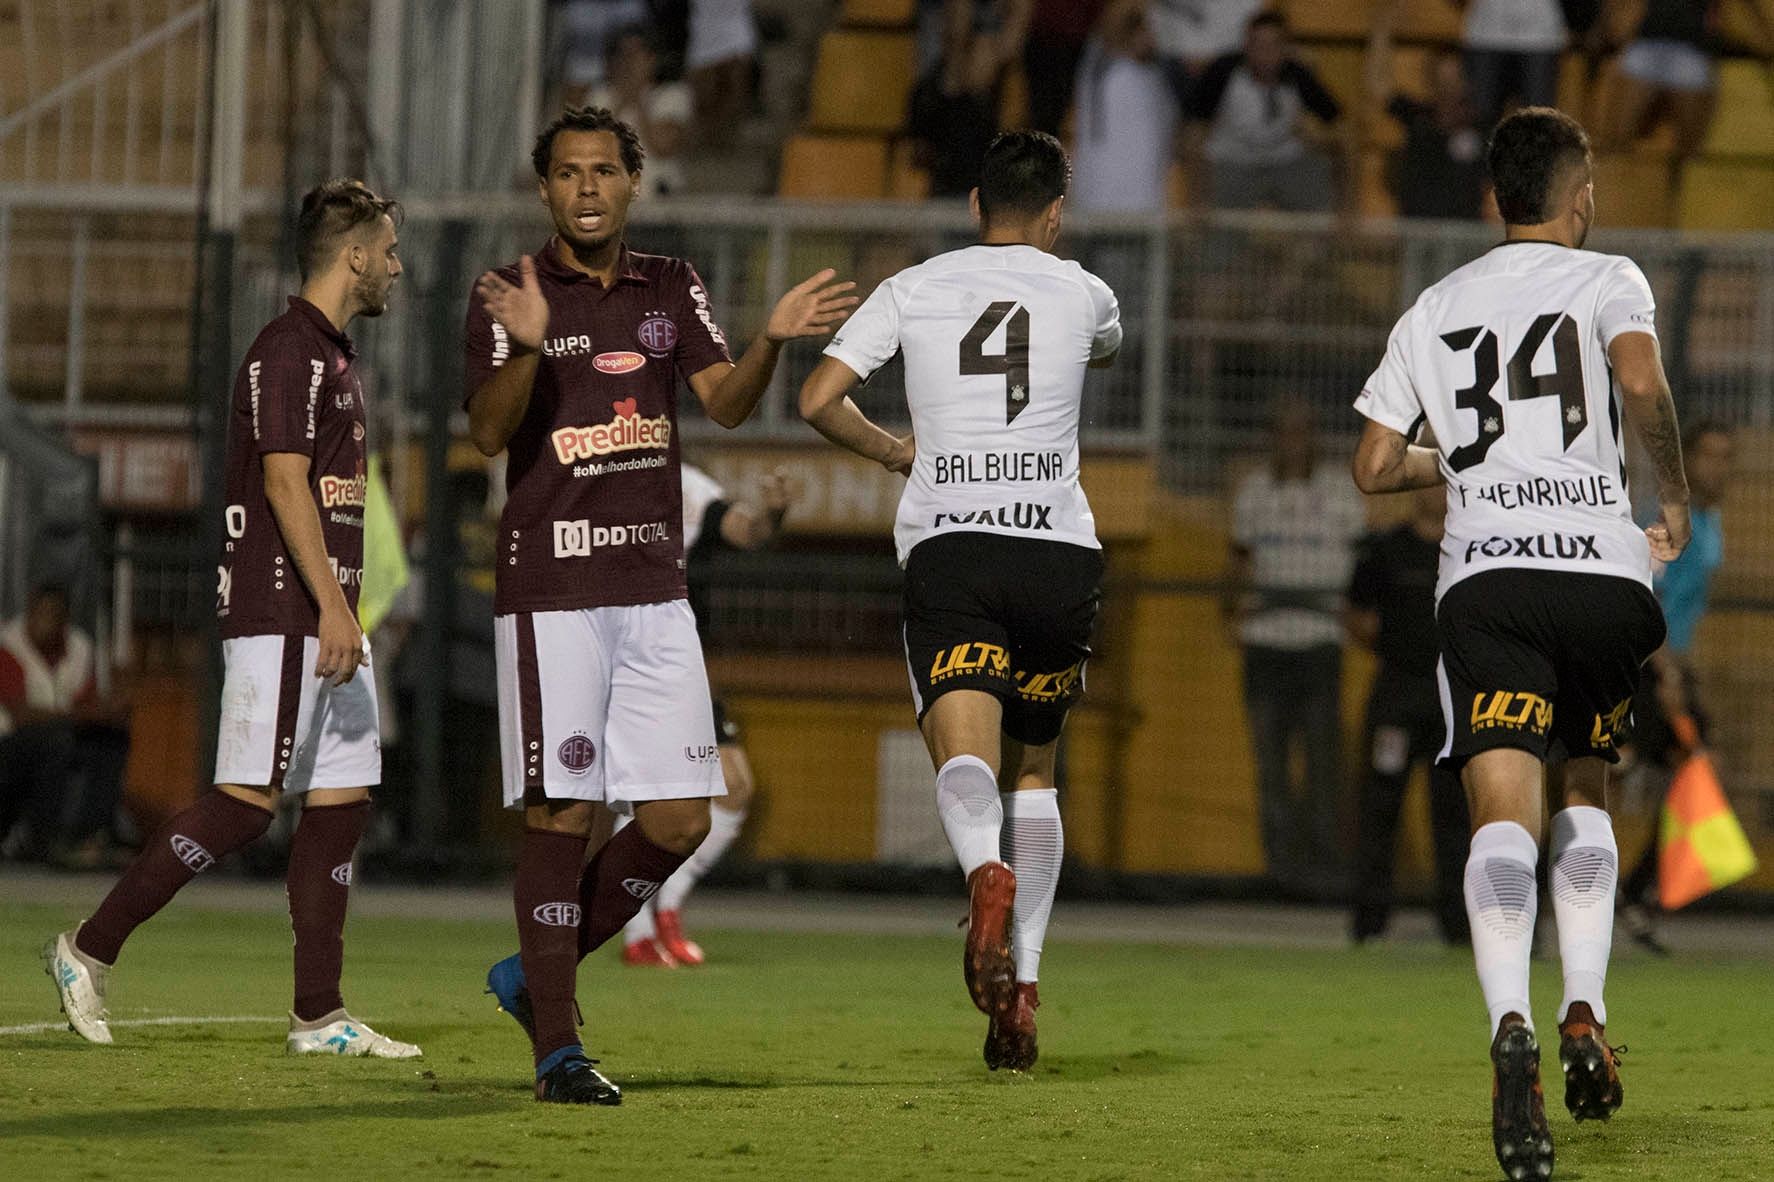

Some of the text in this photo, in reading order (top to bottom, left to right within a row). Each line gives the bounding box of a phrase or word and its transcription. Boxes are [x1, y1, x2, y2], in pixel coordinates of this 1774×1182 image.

[541, 335, 591, 356] LUPO
[958, 300, 1031, 427] 4
[1440, 311, 1588, 473] 34
[552, 413, 671, 465] Predilecta
[935, 452, 1063, 485] BALBUENA
[592, 521, 670, 547] DDTOTAL
[1465, 532, 1602, 564] FOXLUX
